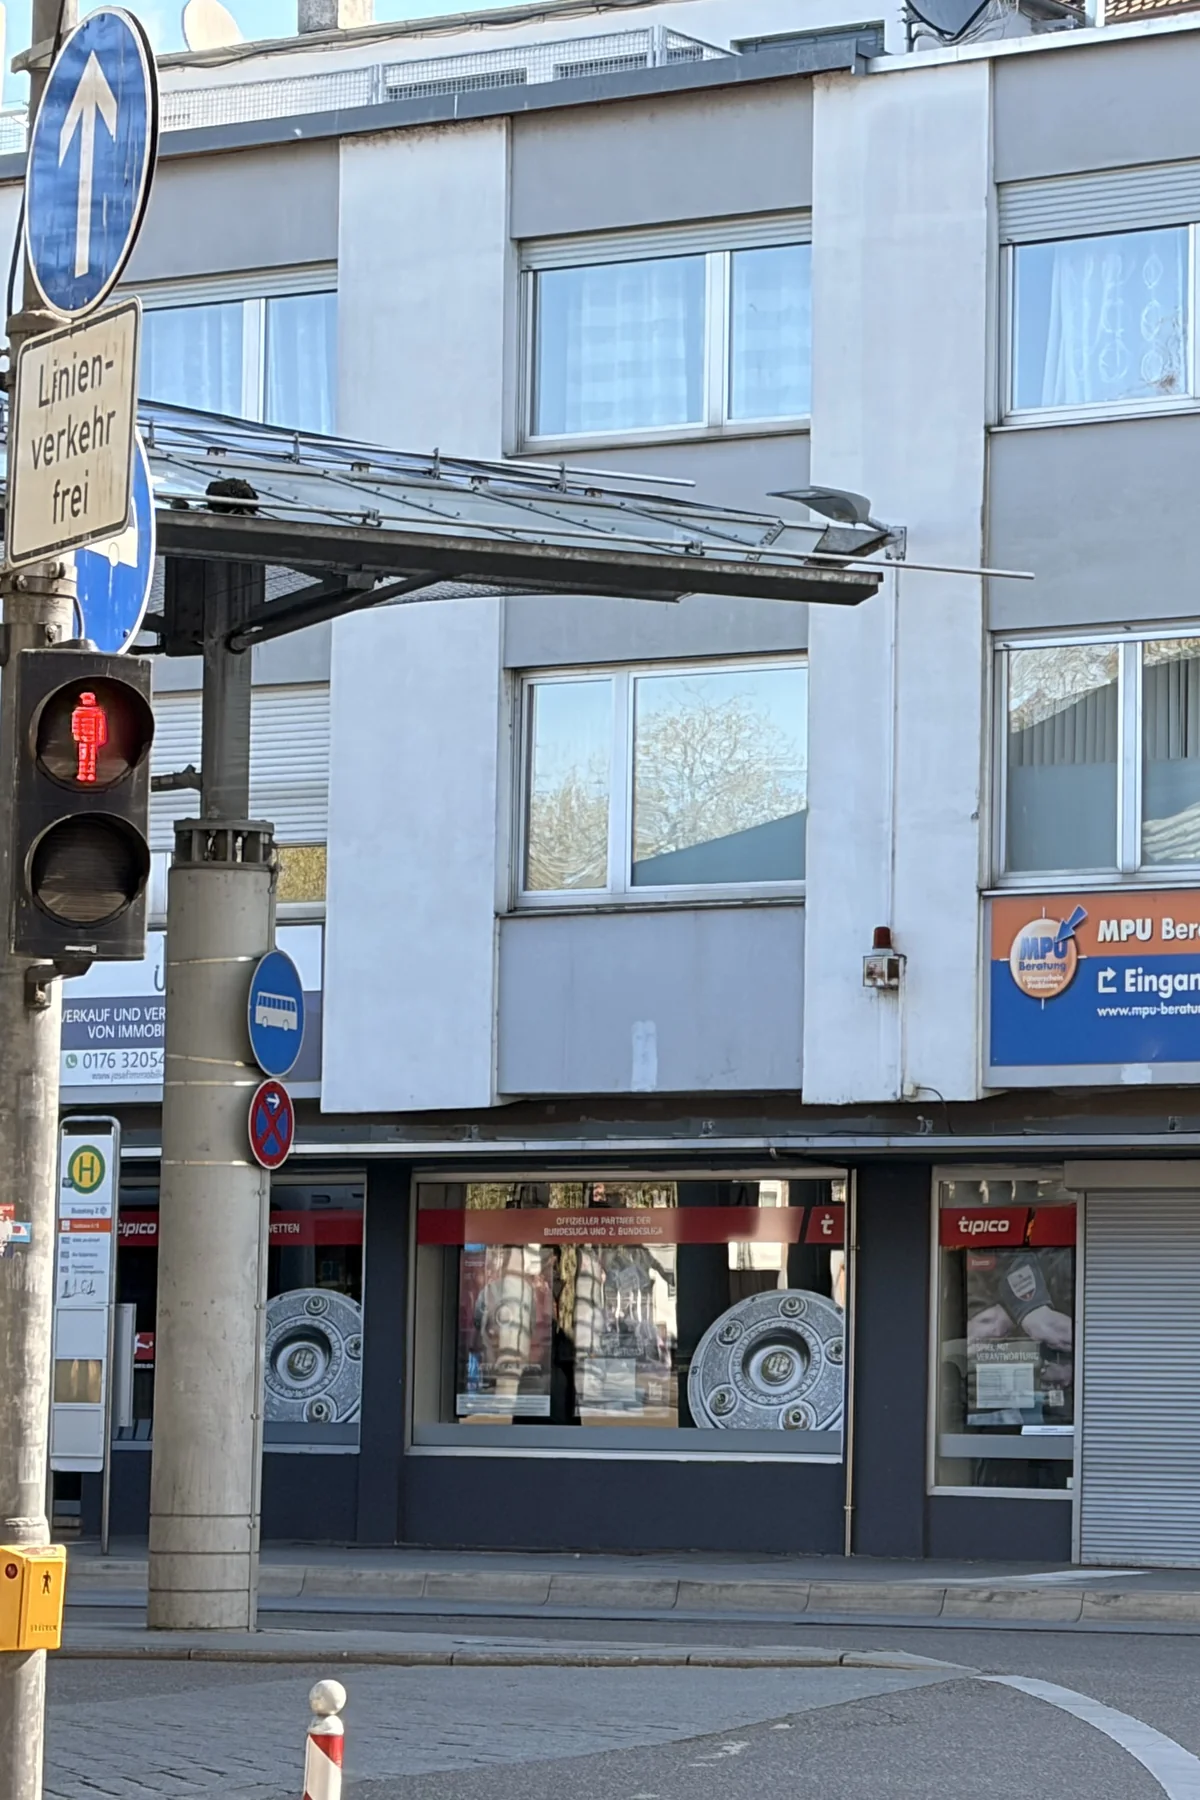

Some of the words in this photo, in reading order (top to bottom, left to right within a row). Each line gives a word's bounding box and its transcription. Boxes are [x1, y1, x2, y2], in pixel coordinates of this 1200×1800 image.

[38, 352, 114, 408] Linien-
[32, 405, 116, 470] verkehr
[53, 470, 89, 524] frei
[1097, 918, 1152, 942] MPU
[1020, 935, 1068, 960] MPU
[1019, 961, 1067, 972] Beratung
[114, 1007, 141, 1021] UND
[88, 1024, 115, 1039] VON
[83, 1052, 116, 1069] 0176
[79, 1156, 95, 1183] H
[556, 1217, 599, 1225] OFFIZIELLER
[601, 1216, 633, 1225] PARTNER
[958, 1216, 1010, 1235] tipico
[544, 1227, 588, 1236] BUNDESLIGA
[590, 1227, 606, 1235] UND
[618, 1226, 663, 1235] BUNDESLIGA
